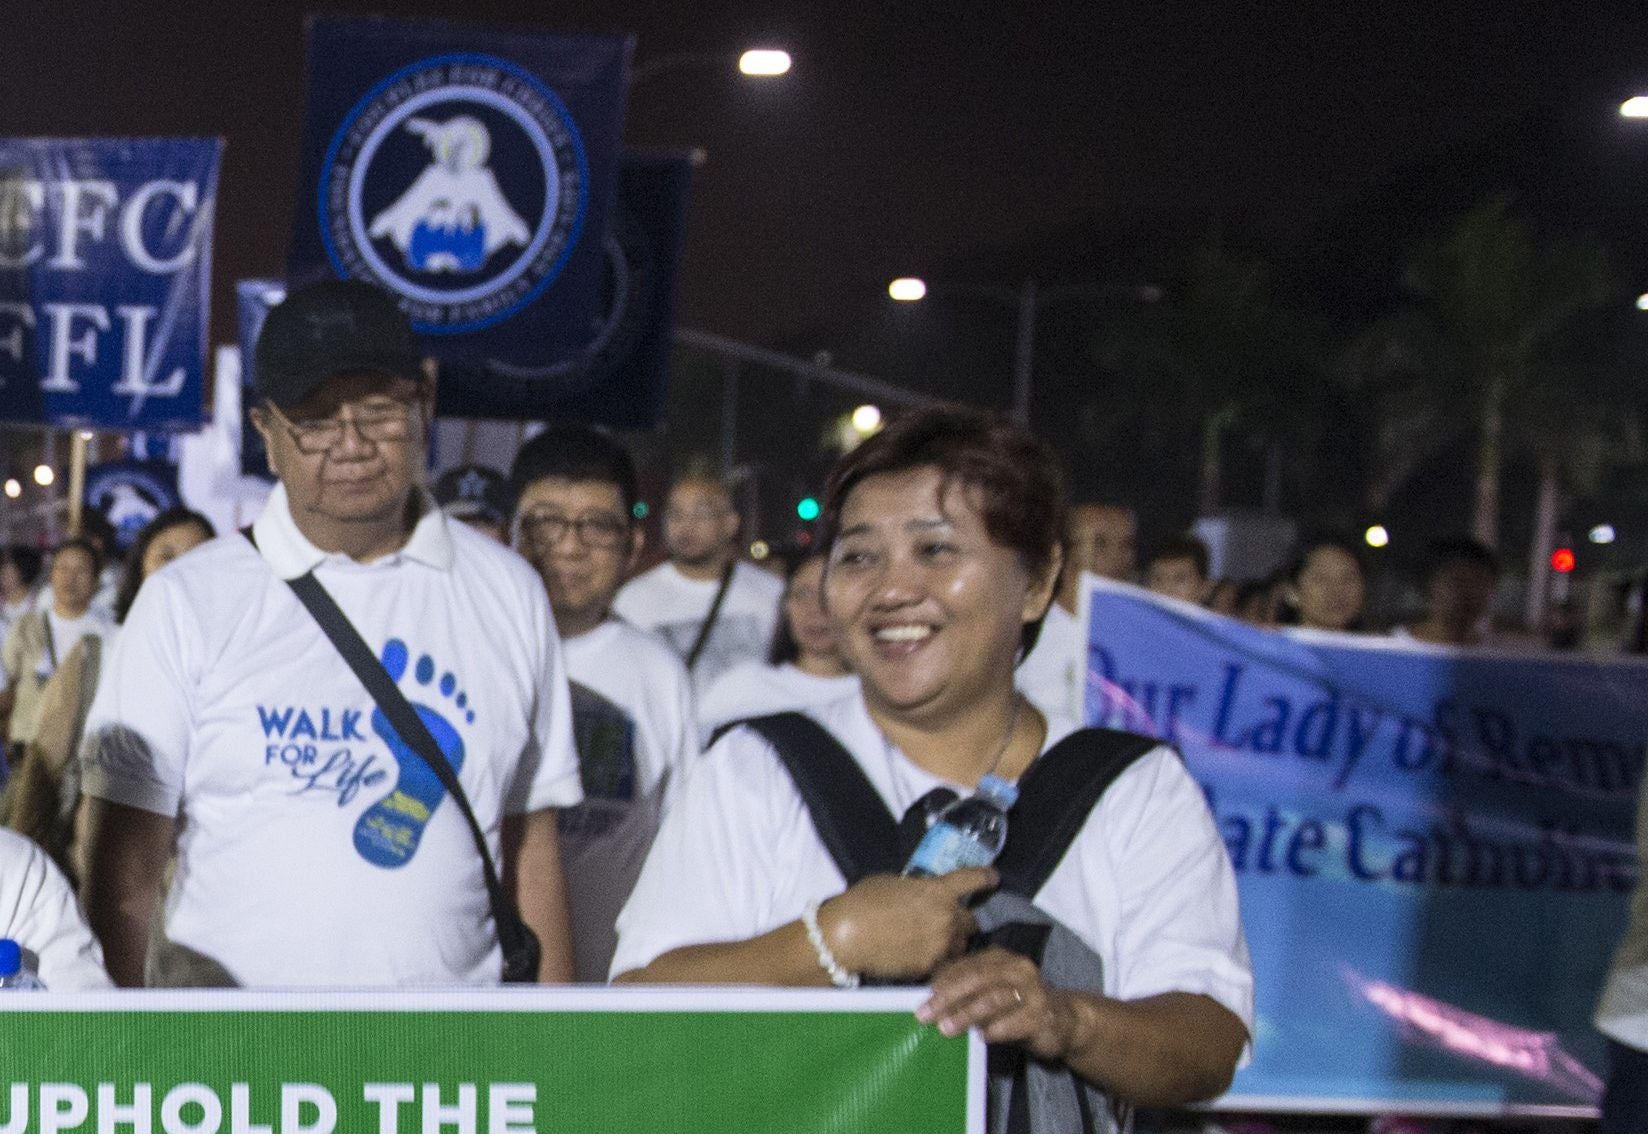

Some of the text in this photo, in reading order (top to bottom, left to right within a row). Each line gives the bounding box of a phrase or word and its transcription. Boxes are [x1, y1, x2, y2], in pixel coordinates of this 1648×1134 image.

[256, 704, 367, 742] WALK
[1210, 660, 1384, 789] Lady
[1472, 706, 1645, 794] Rem
[265, 744, 318, 766] FOR
[286, 748, 386, 808] Life
